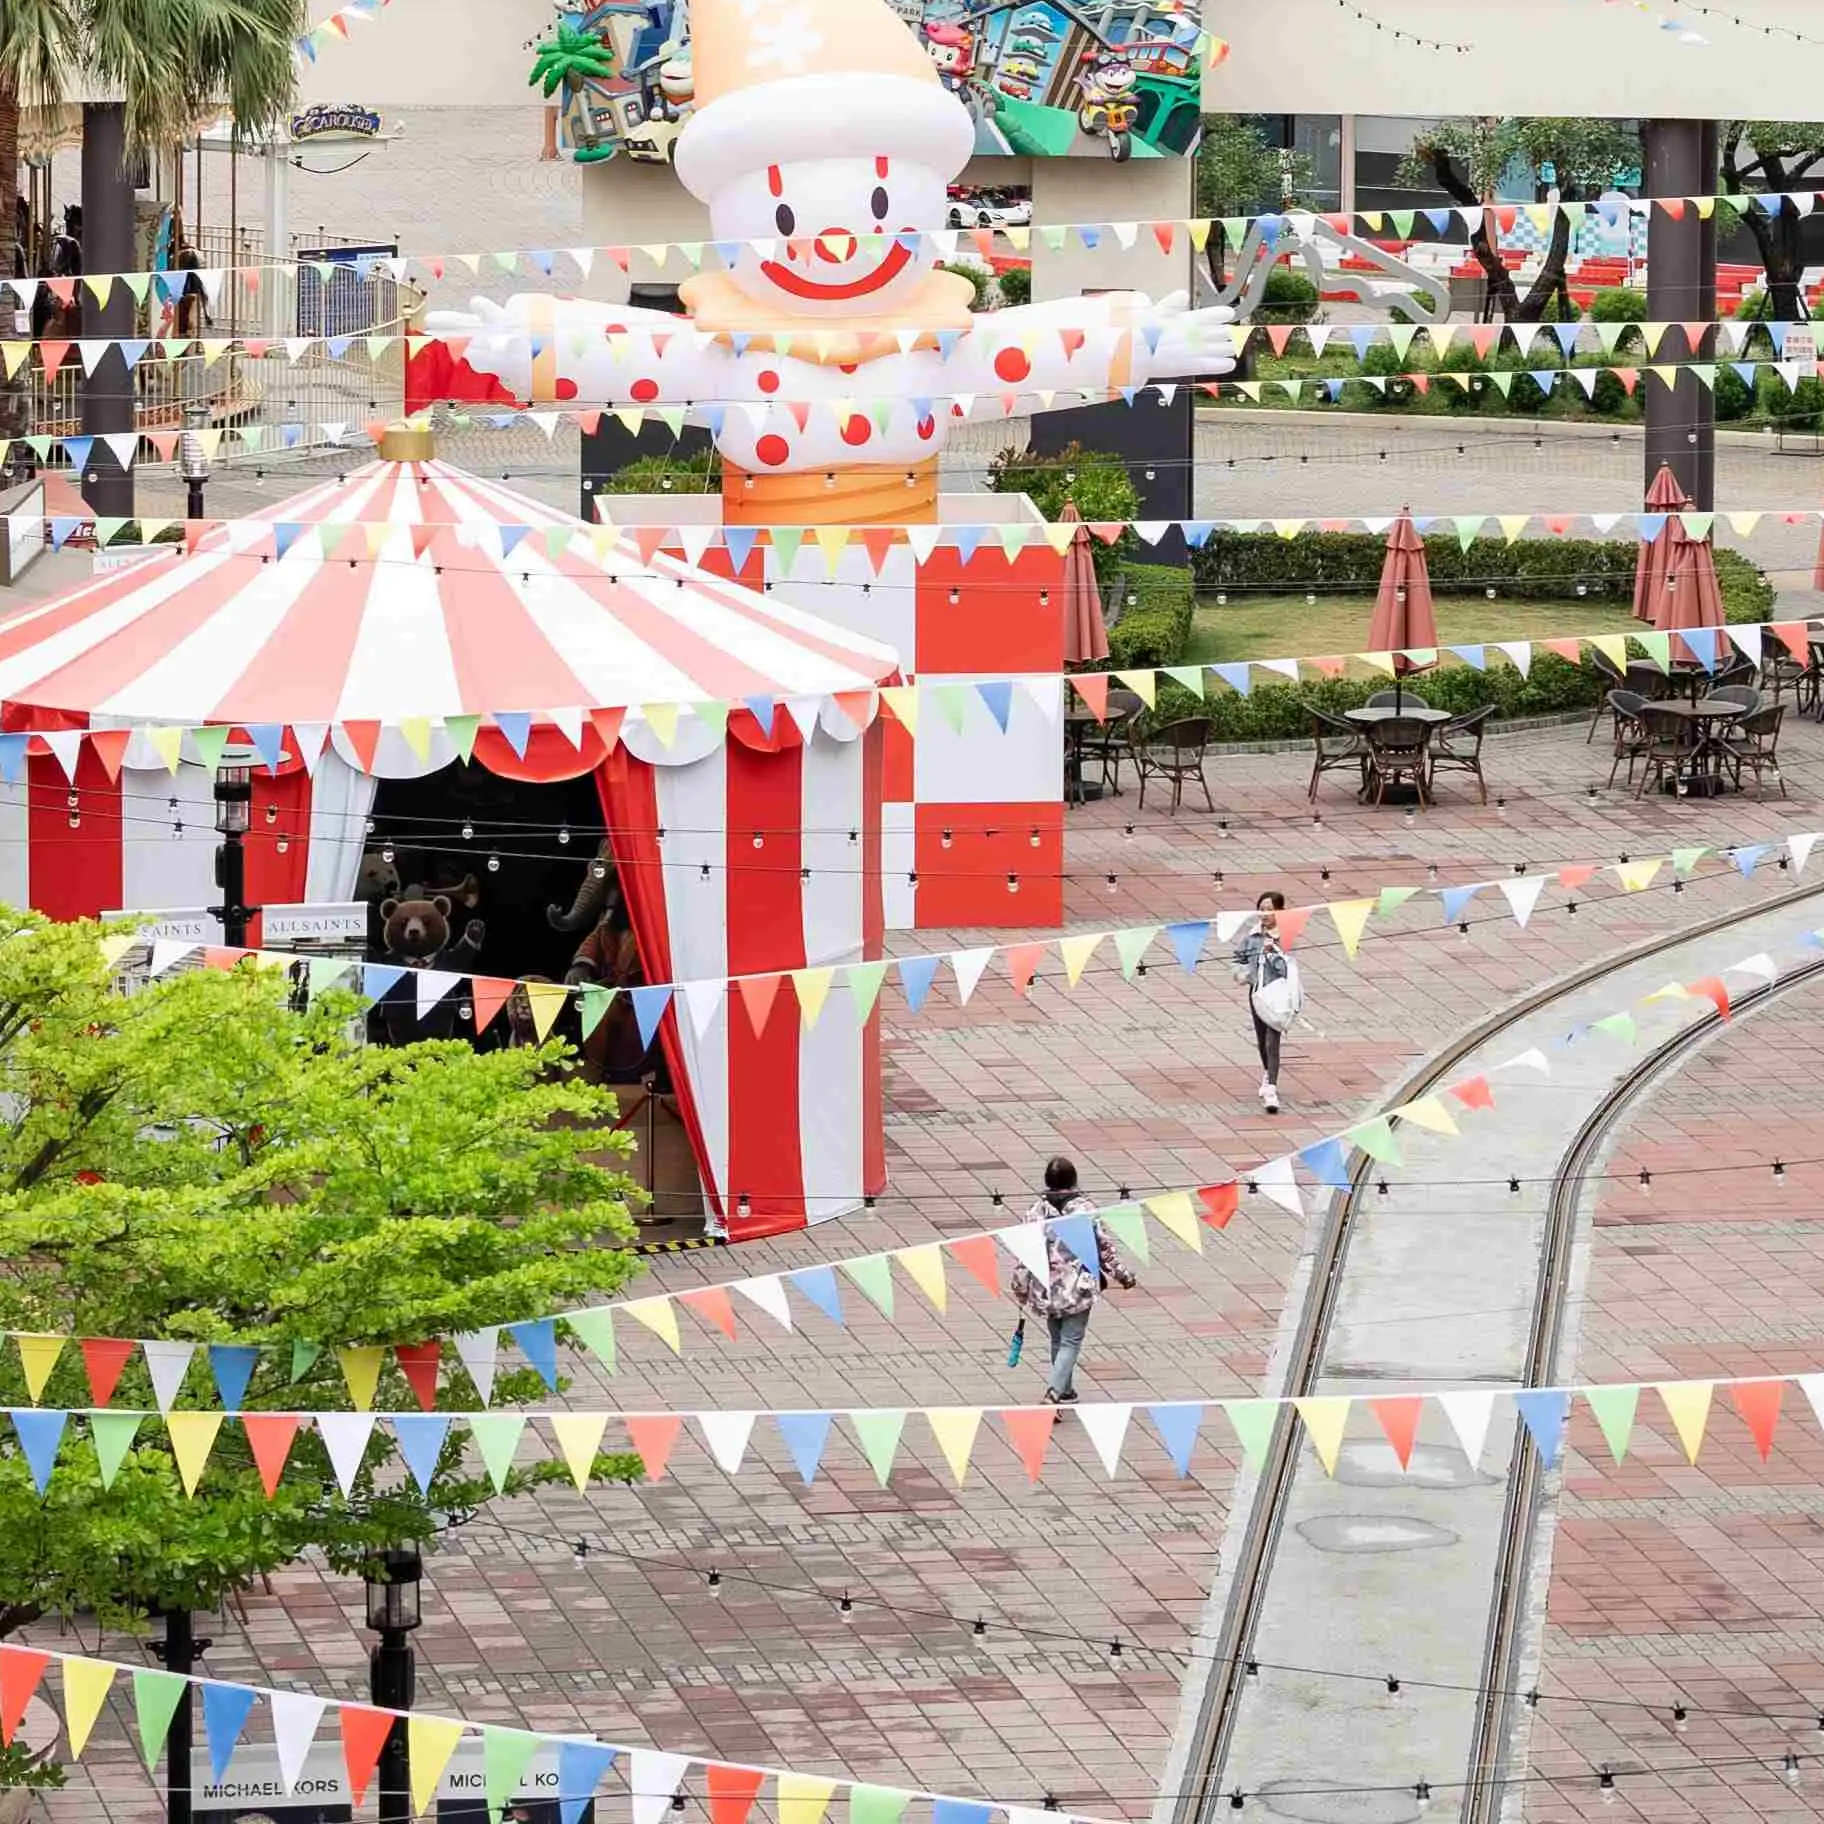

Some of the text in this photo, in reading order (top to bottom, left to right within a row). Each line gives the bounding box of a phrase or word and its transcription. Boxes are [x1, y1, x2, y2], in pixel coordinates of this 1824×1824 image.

[268, 918, 362, 934] ALLSAINTS
[449, 1772, 527, 1789] MICL
[203, 1781, 283, 1799] MICHAEL
